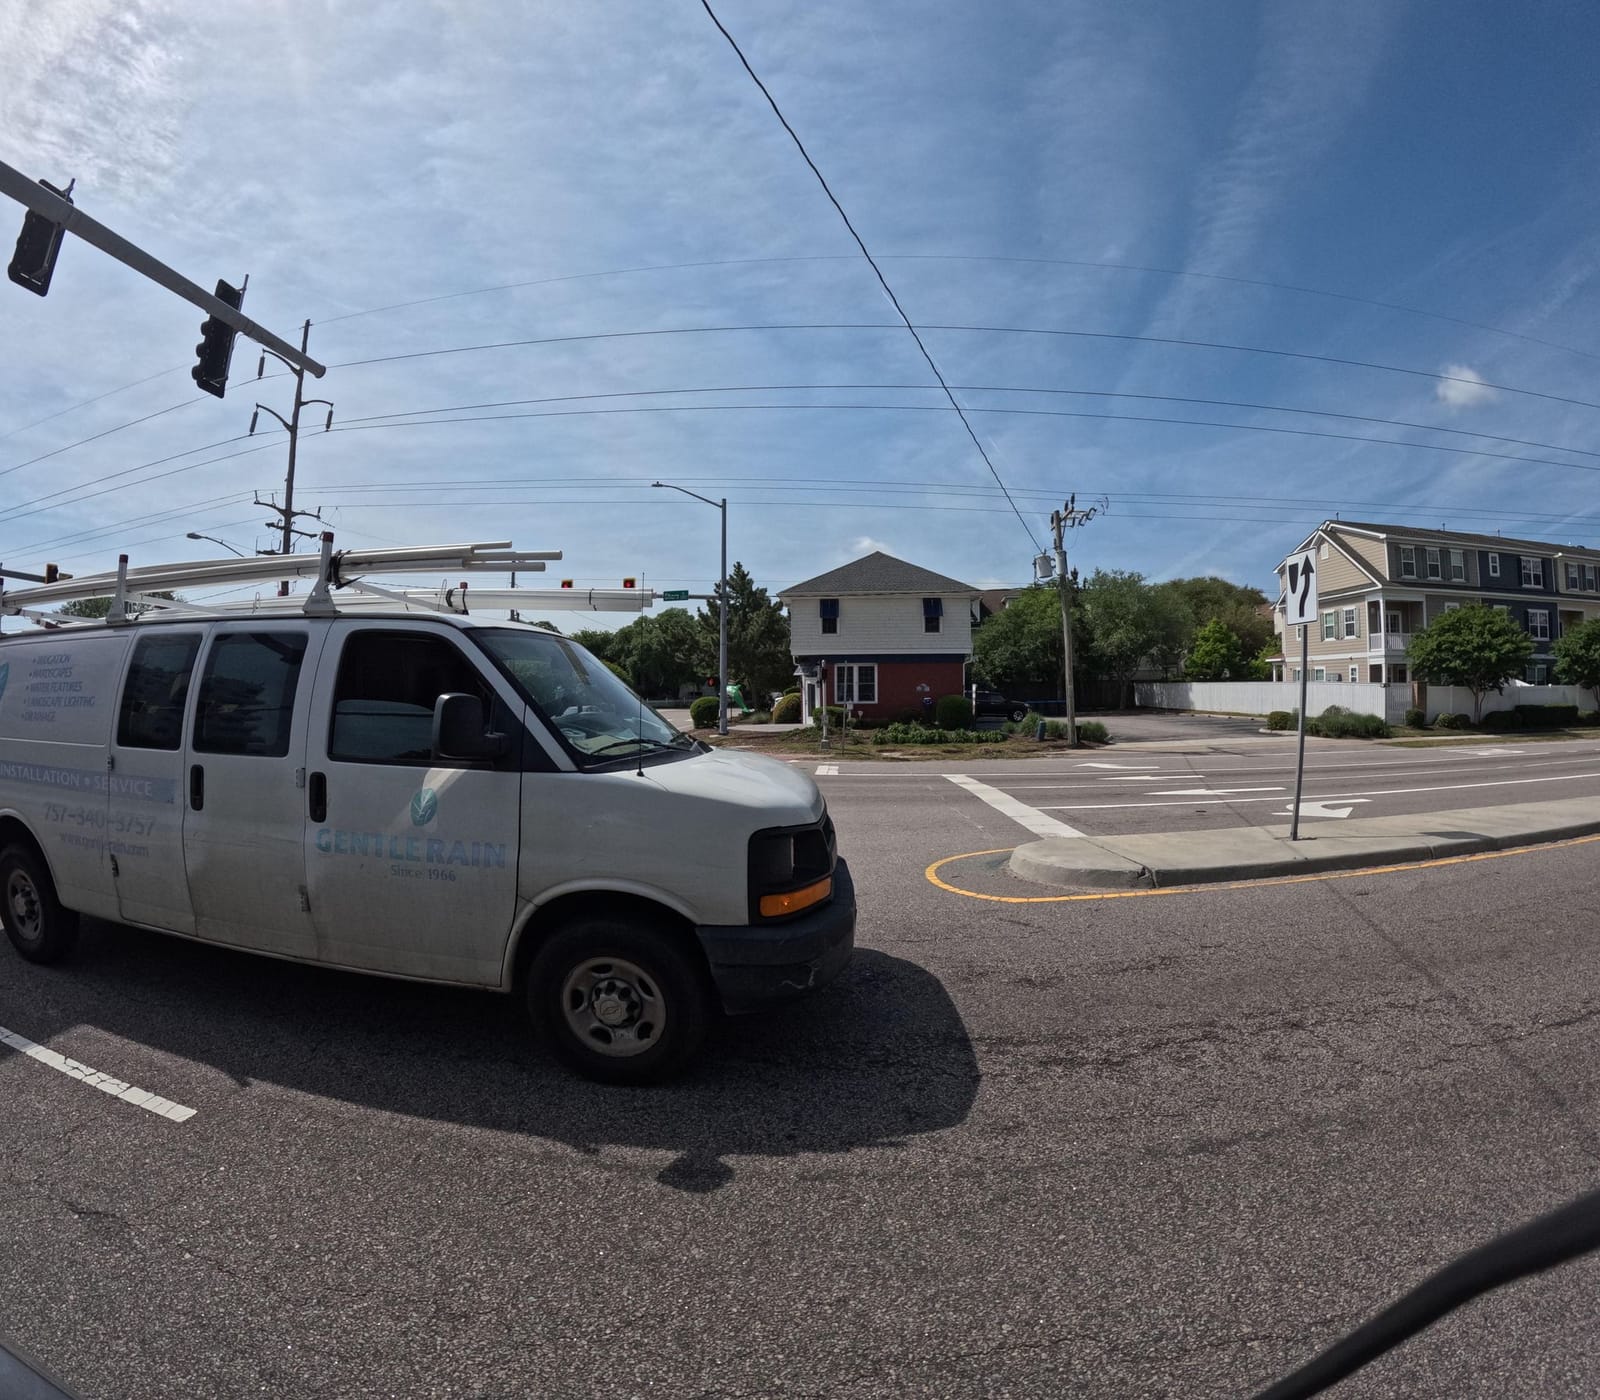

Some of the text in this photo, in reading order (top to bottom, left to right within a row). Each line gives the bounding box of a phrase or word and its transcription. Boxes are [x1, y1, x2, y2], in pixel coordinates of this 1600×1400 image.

[0, 763, 153, 796] INSTALLATION SERVICE
[390, 864, 456, 882] Since 1966
